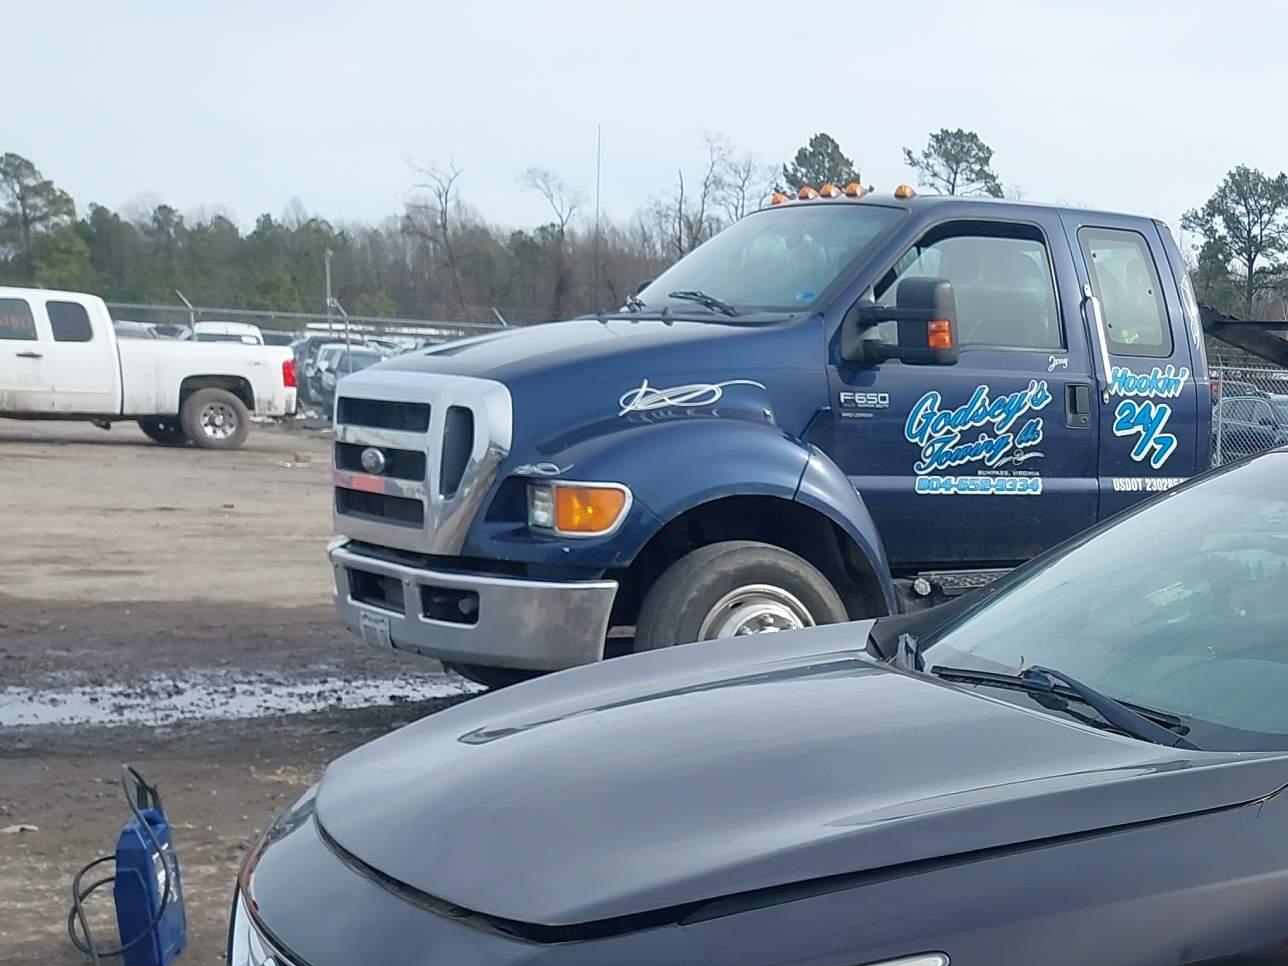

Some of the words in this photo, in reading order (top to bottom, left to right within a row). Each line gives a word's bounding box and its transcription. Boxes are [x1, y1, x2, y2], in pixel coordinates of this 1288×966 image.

[839, 392, 889, 404] F-650
[904, 379, 1052, 447] Godsey's
[913, 432, 1014, 475] Towing
[1112, 399, 1178, 469] 24/7
[1112, 478, 1143, 491] USDOT
